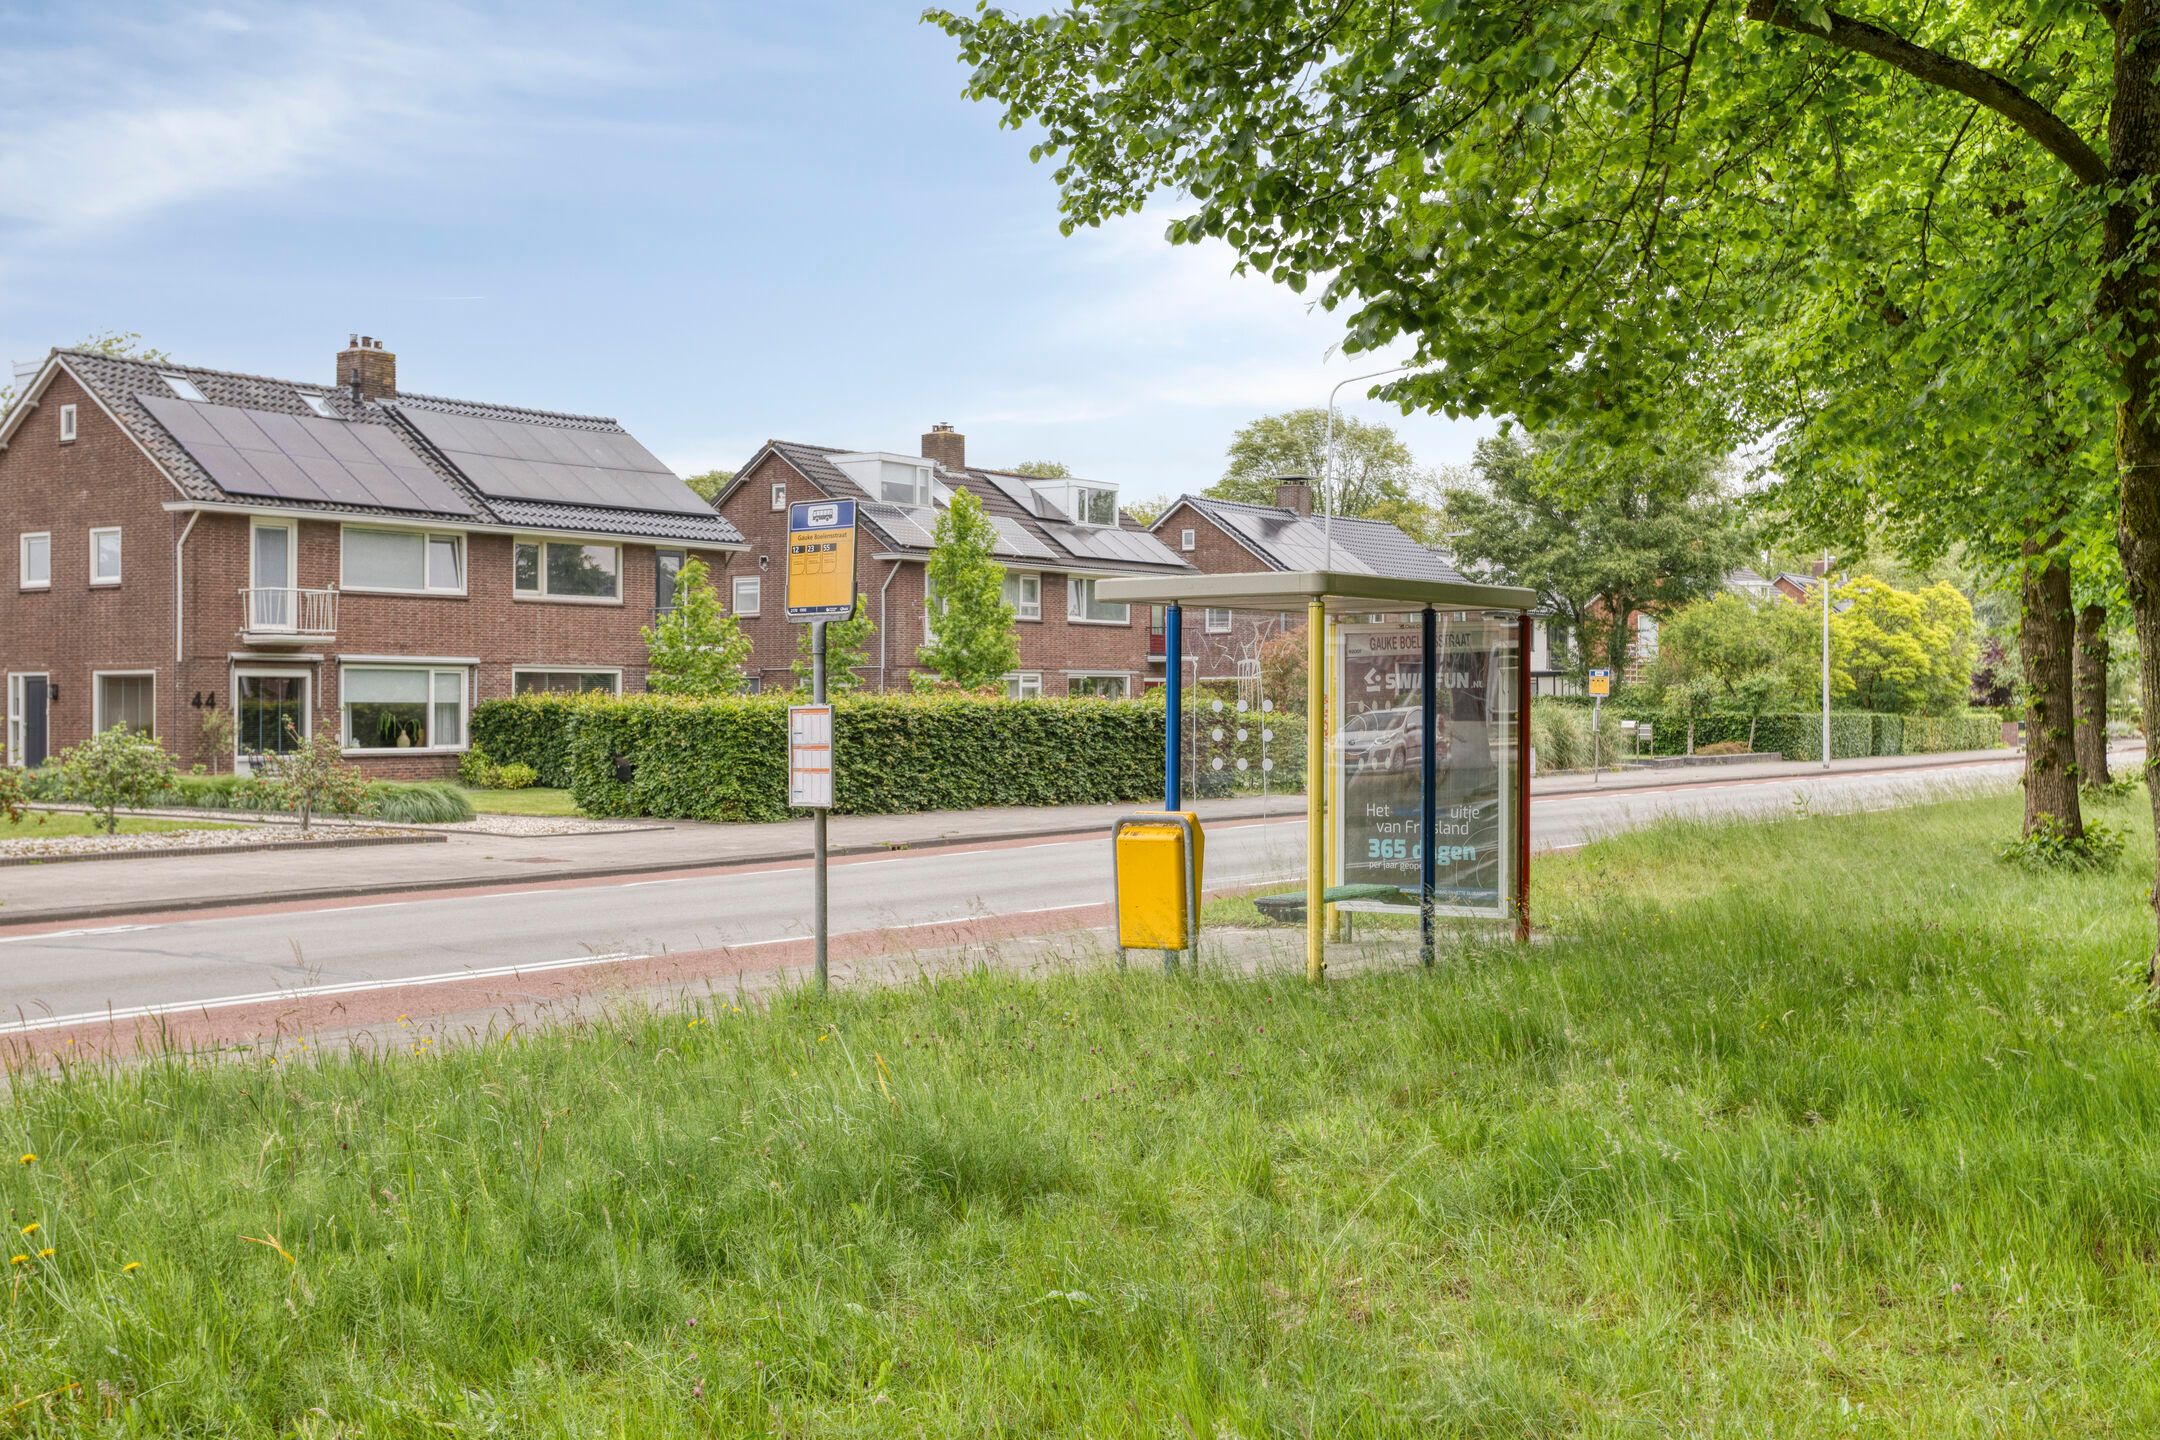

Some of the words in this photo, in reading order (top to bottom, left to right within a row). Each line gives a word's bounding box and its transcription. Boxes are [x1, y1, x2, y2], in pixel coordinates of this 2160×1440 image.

[1369, 637, 1398, 650] GAUKE
[1400, 633, 1471, 649] BOELSTRAAT
[1385, 672, 1483, 689] SWIFUN.NL
[192, 691, 216, 709] 44
[1366, 803, 1390, 817] Het
[1450, 805, 1480, 822] uitje
[1376, 822, 1401, 833] van
[1405, 820, 1469, 835] Frsland
[1368, 838, 1407, 859] 365
[1412, 840, 1476, 866] dgen
[1369, 862, 1382, 870] per
[1383, 860, 1398, 870] jaar
